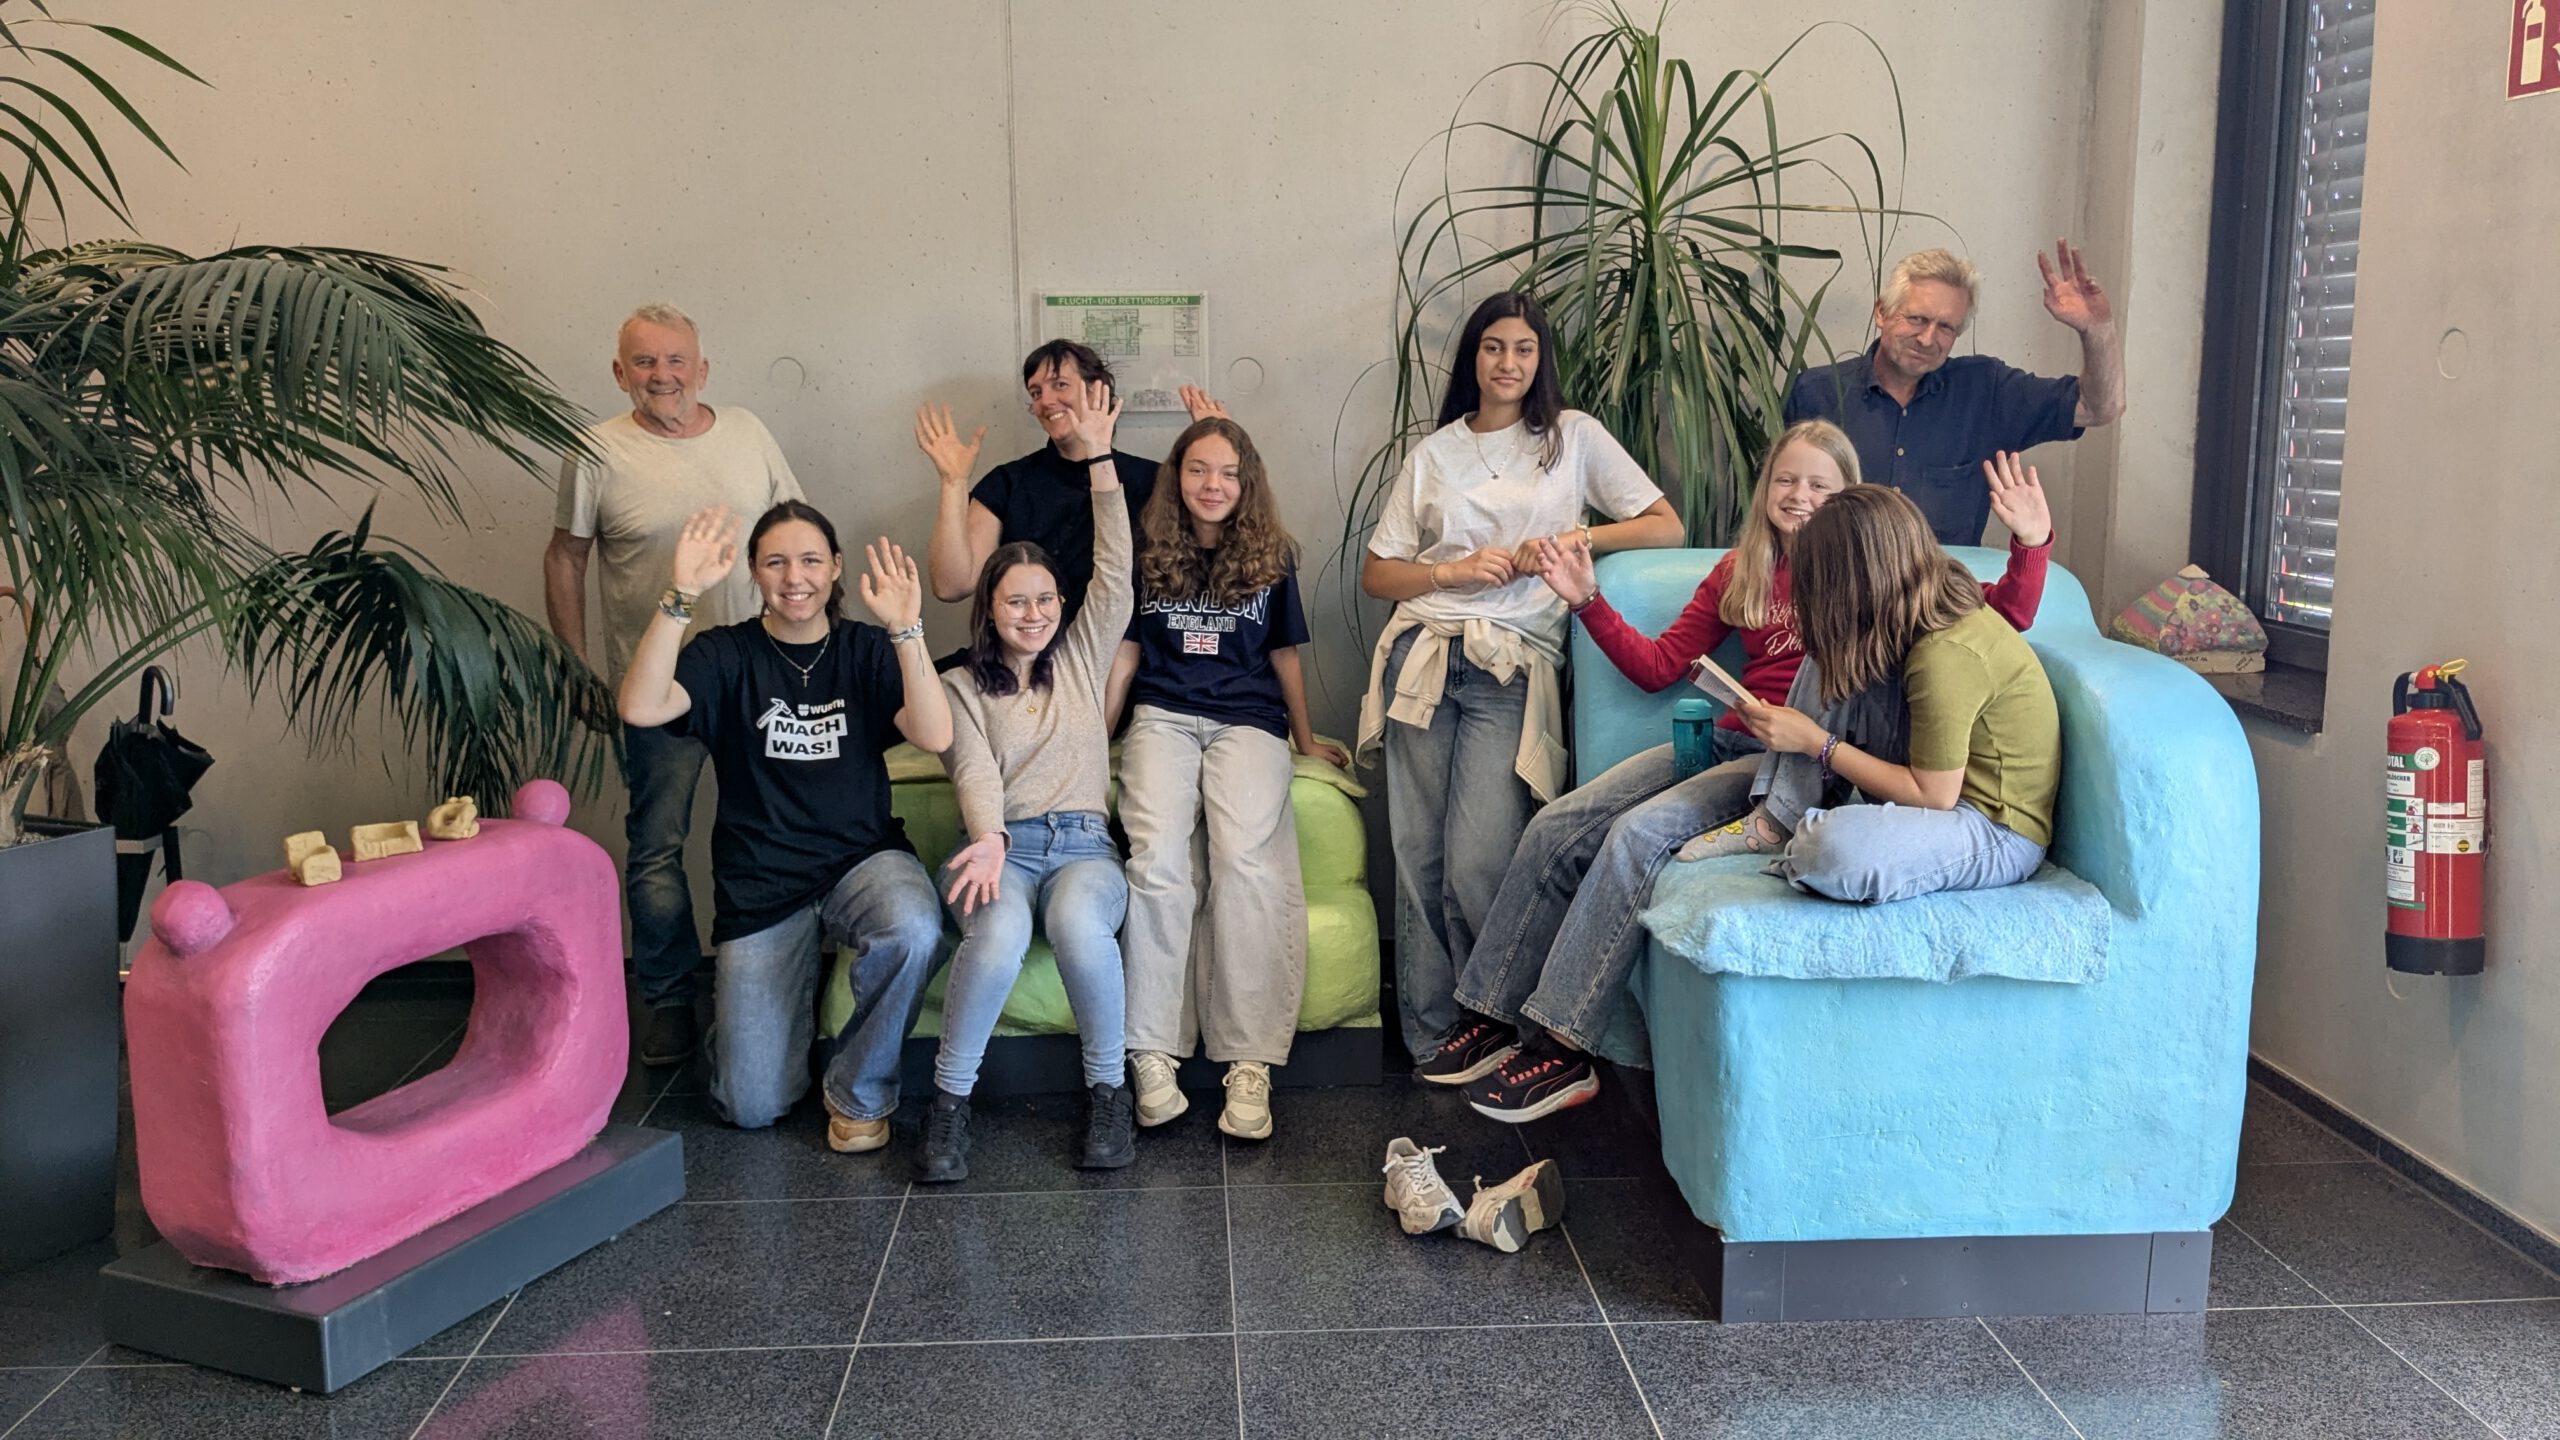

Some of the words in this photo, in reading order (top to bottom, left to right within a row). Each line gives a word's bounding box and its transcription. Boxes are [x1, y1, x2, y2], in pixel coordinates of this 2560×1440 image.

[1059, 297, 1097, 305] FLUCHT-
[1098, 297, 1117, 305] UND
[1118, 297, 1188, 305] RETTUNGSPLAN
[1168, 613, 1236, 632] ENGLAND
[774, 719, 840, 736] MACH
[772, 740, 833, 755] WAS!
